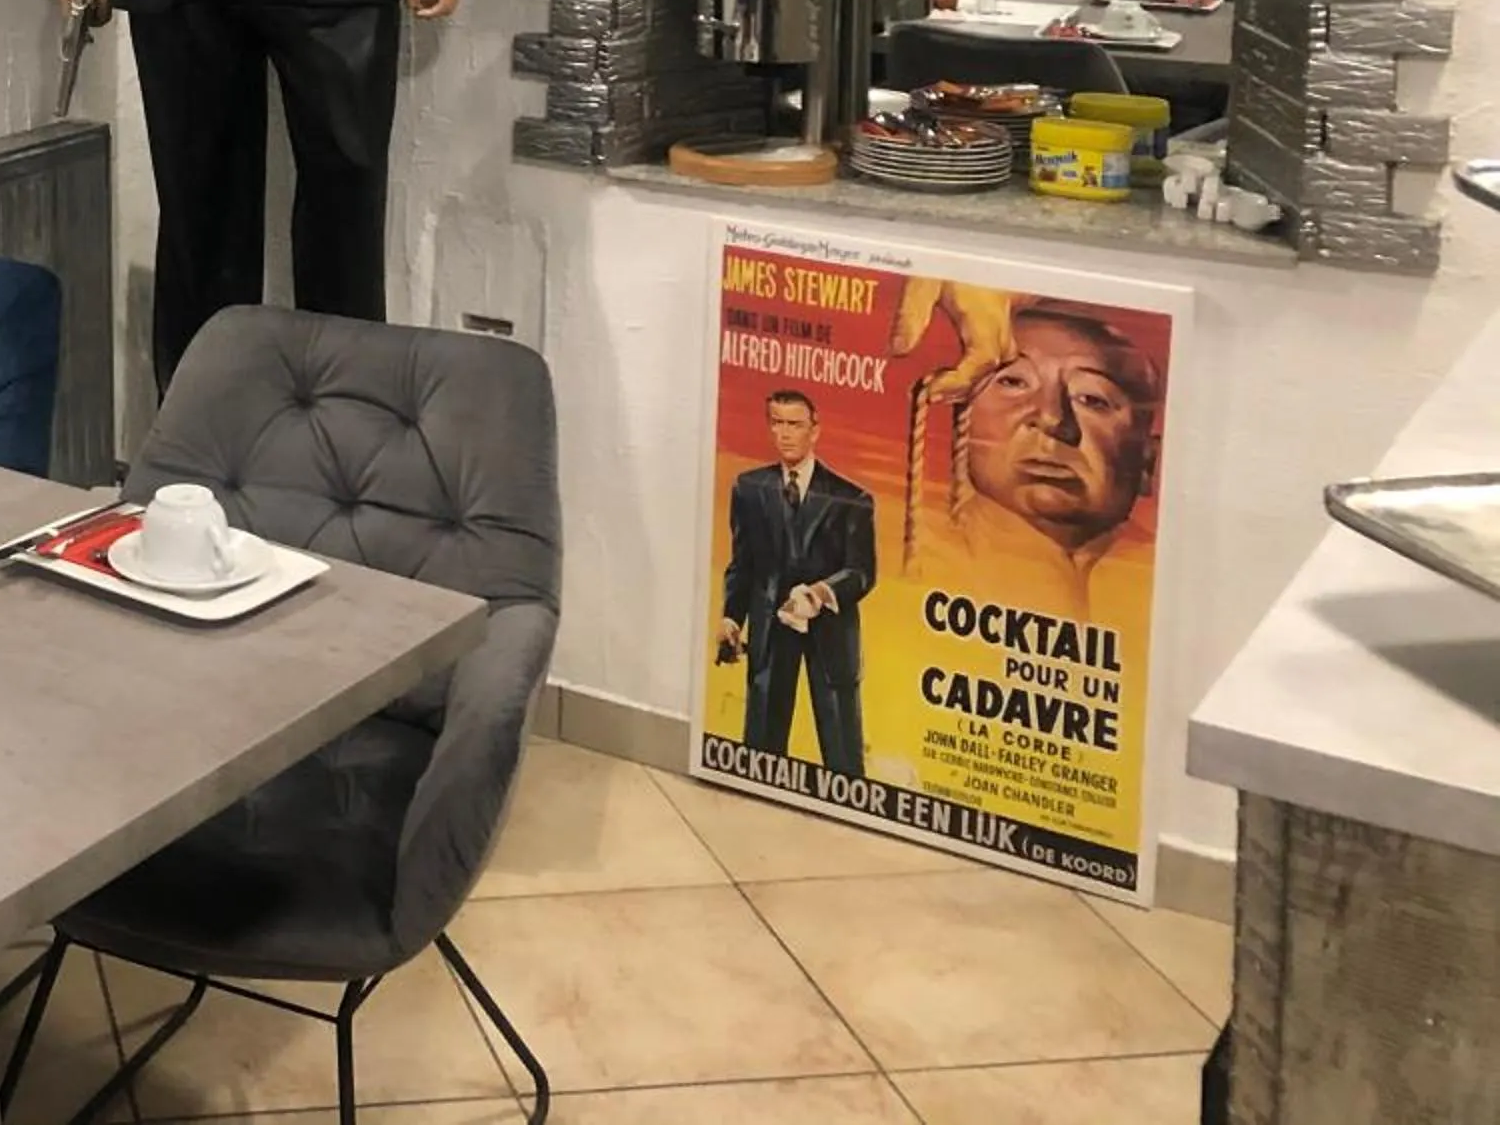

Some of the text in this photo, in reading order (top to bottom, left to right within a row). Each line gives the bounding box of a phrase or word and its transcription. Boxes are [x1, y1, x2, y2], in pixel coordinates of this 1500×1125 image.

[723, 255, 879, 315] JAMES STEWART
[722, 330, 887, 394] ALFRED HITCHCOCK
[924, 590, 1121, 672] COCKTAIL
[921, 666, 1119, 751] CADAVRE
[1005, 657, 1120, 704] POUR UN
[704, 736, 811, 794] COCKTAIL
[816, 769, 887, 816] VOOR
[897, 791, 951, 834] EEN
[960, 809, 1019, 853] LIJK
[924, 730, 957, 750] JOHN
[1051, 763, 1118, 795] GRANGER
[963, 775, 1076, 817] JOAN CHANDLER
